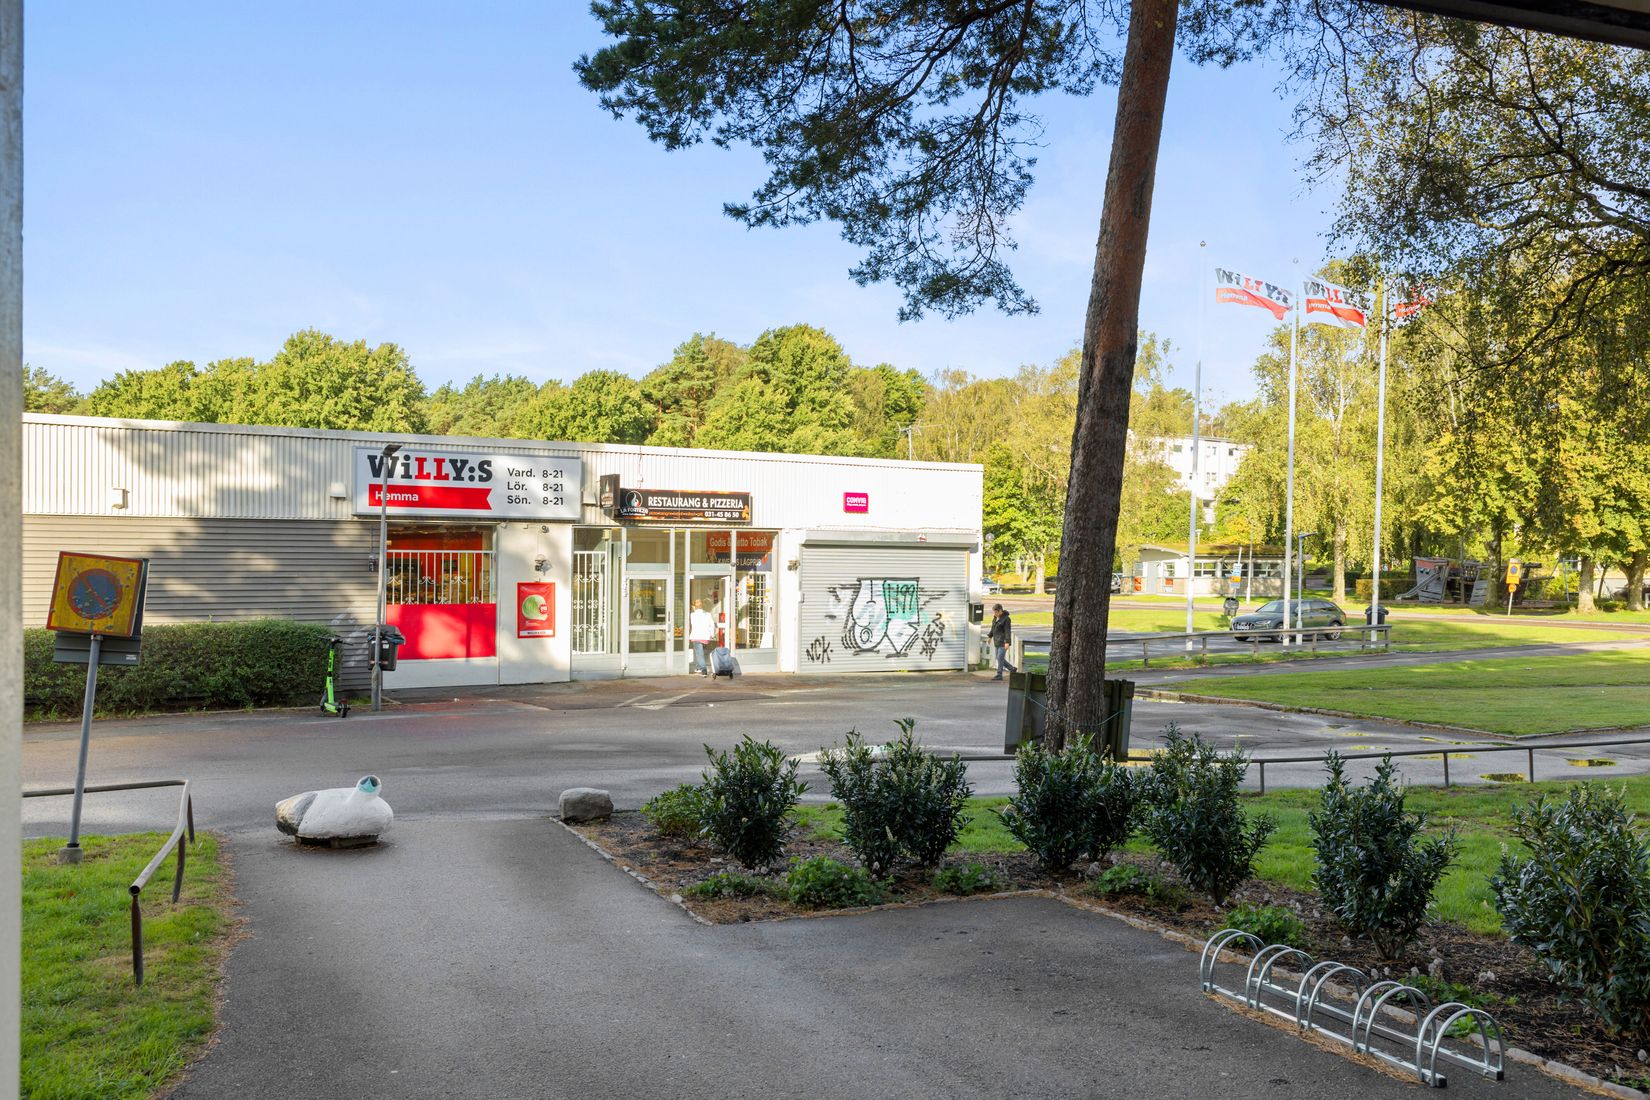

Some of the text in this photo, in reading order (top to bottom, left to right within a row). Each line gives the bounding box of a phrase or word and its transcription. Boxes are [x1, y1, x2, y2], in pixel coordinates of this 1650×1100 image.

[507, 467, 564, 479] Vard. 8-21
[507, 481, 564, 492] Lör. 8-21
[375, 490, 419, 502] Hemma
[507, 494, 564, 506] Sön. 8-21
[648, 496, 743, 509] RESTAURANG & PIZZERIA
[750, 536, 768, 547] Tobak
